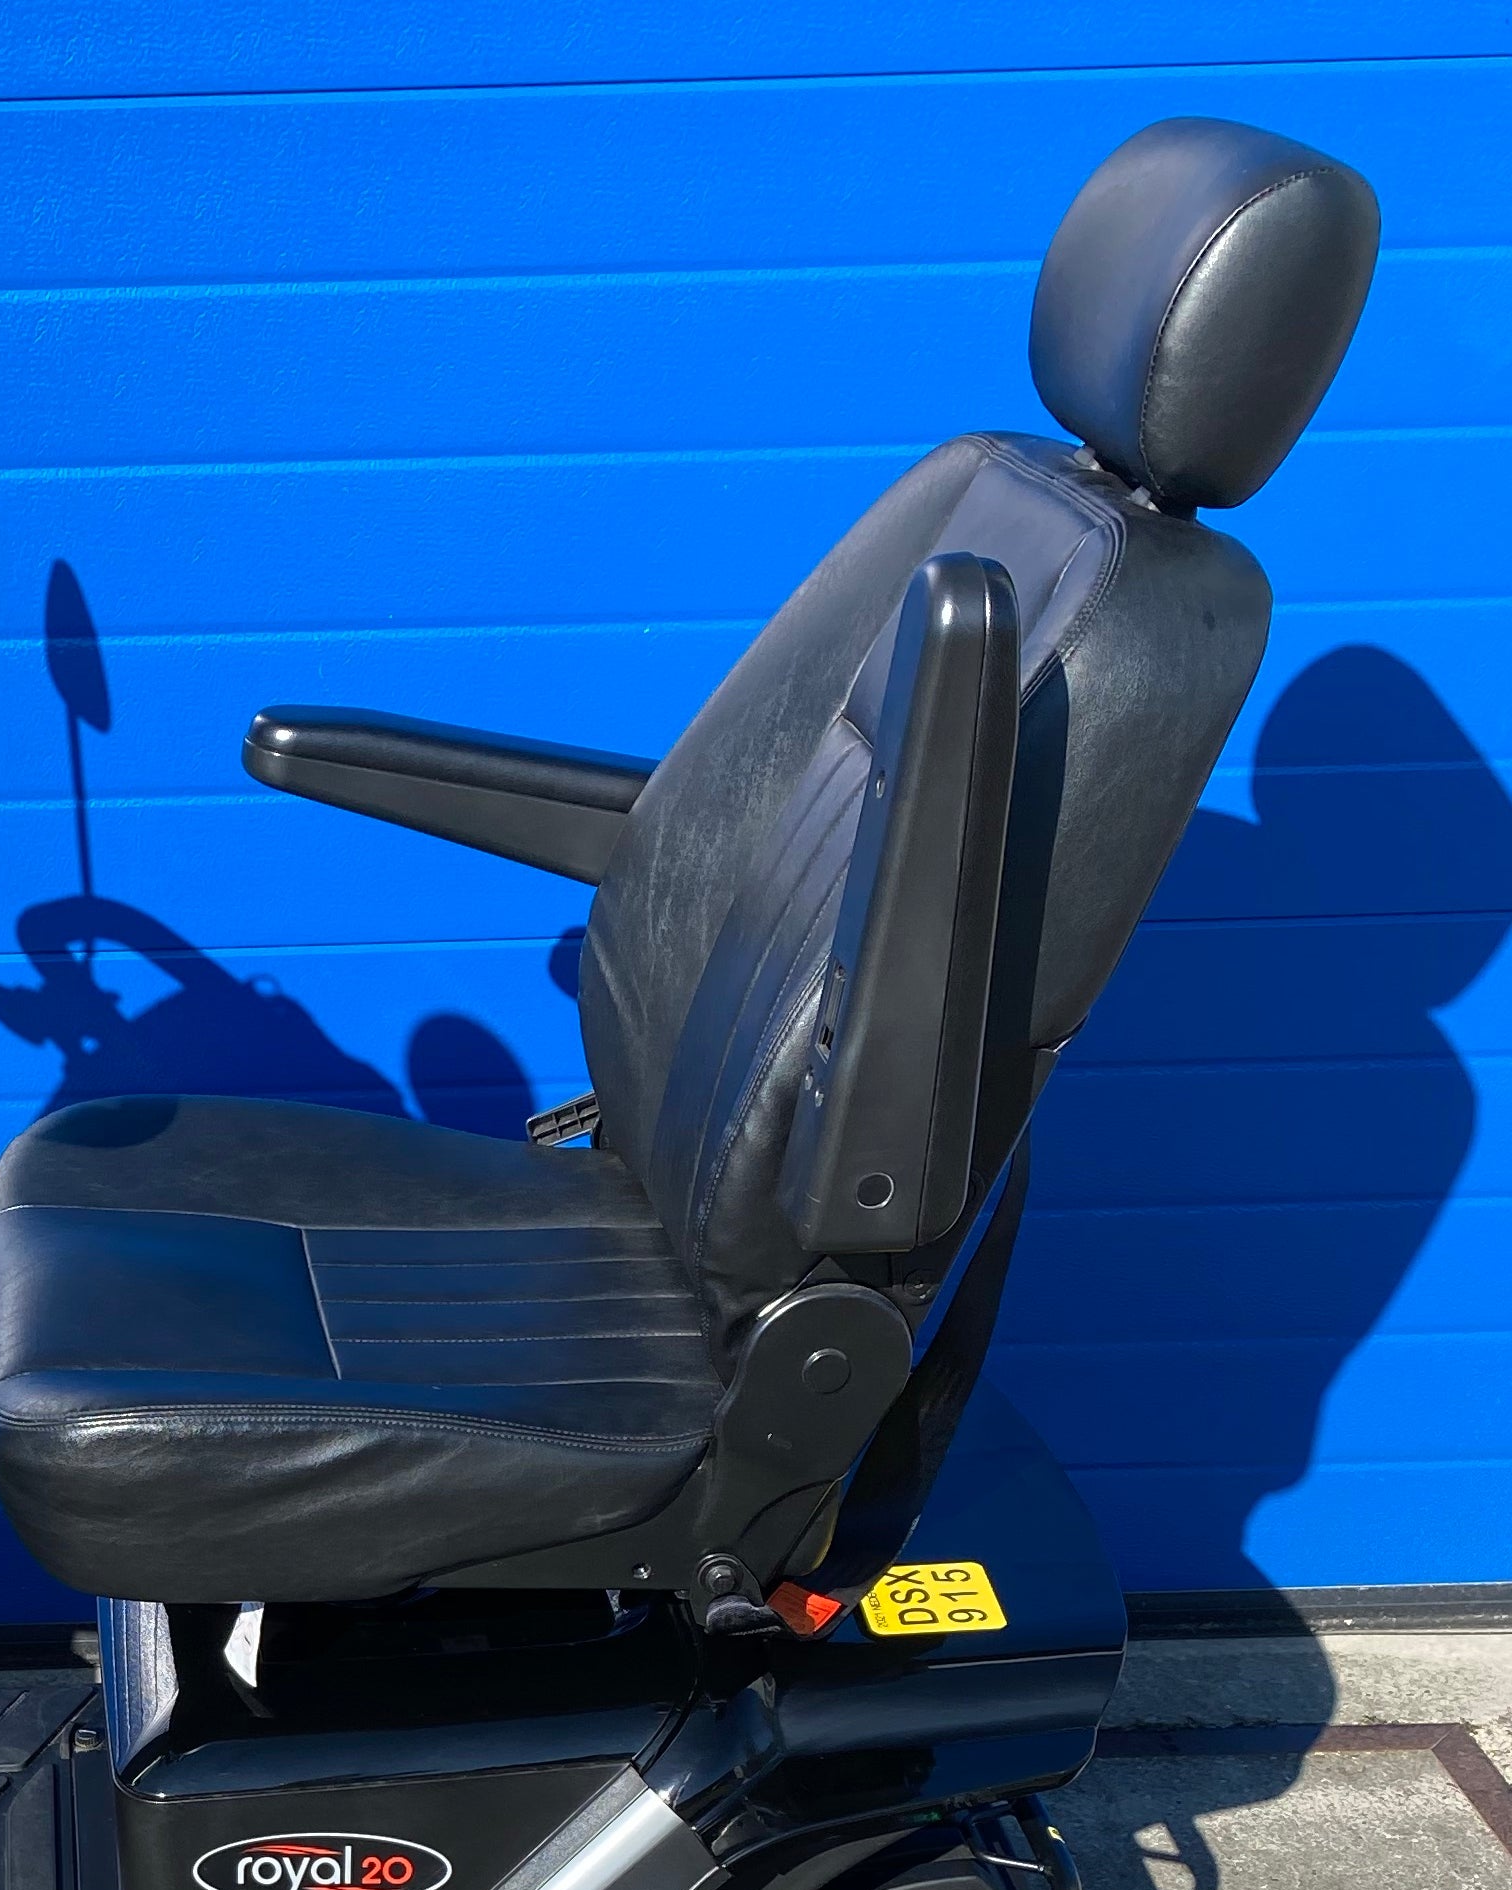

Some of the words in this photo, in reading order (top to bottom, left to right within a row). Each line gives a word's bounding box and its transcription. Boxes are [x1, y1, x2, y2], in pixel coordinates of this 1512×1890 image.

[885, 1569, 939, 1625] DSX
[930, 1569, 988, 1623] 915
[361, 1856, 413, 1885] 20
